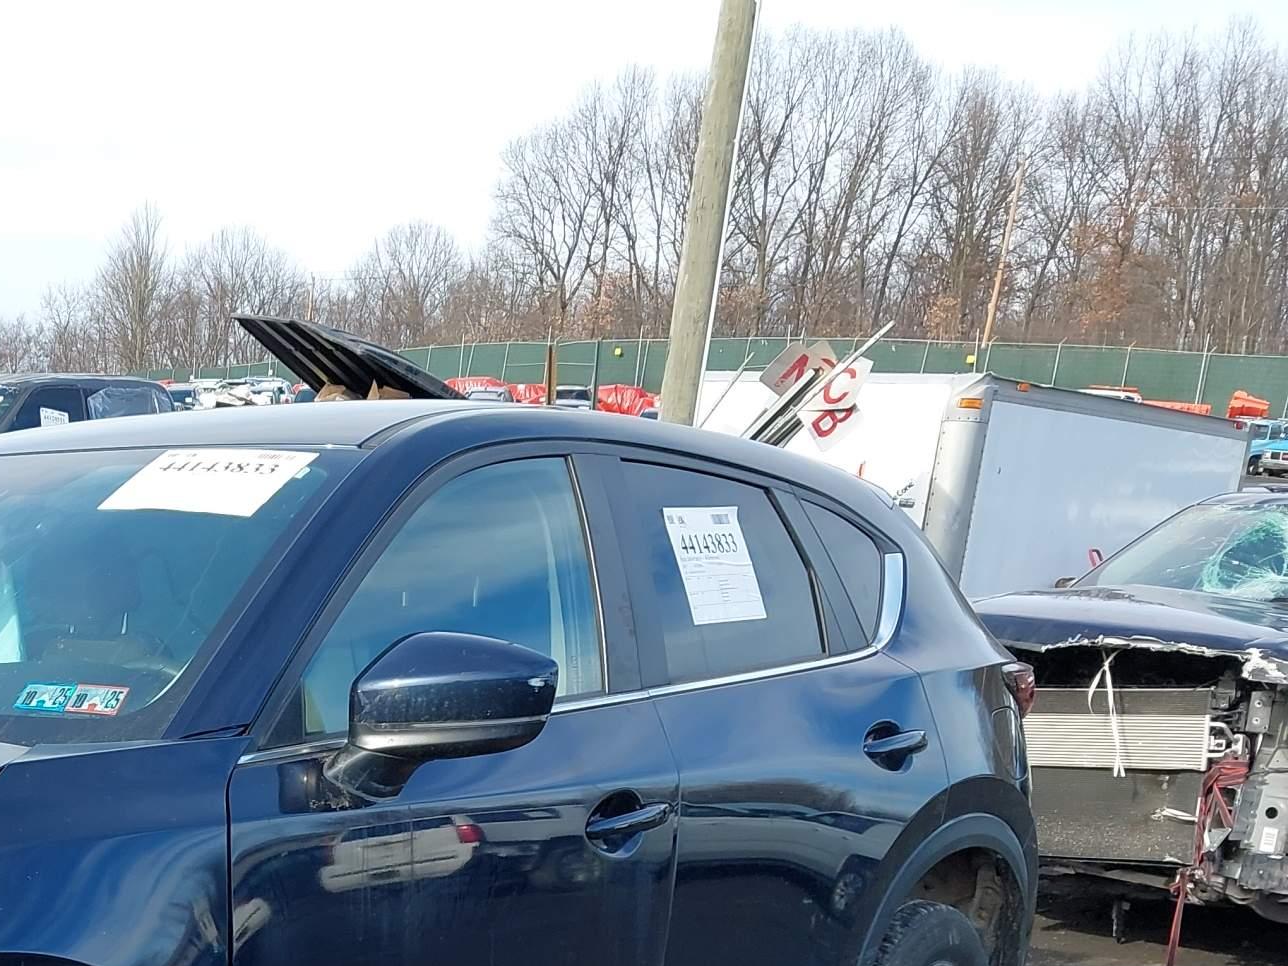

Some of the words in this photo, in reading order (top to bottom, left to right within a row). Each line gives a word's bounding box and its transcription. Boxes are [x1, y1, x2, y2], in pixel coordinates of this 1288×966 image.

[823, 367, 857, 405] C
[159, 461, 280, 475] 44143833
[680, 532, 738, 554] 44143833
[52, 688, 73, 705] 25
[104, 690, 124, 709] 25
